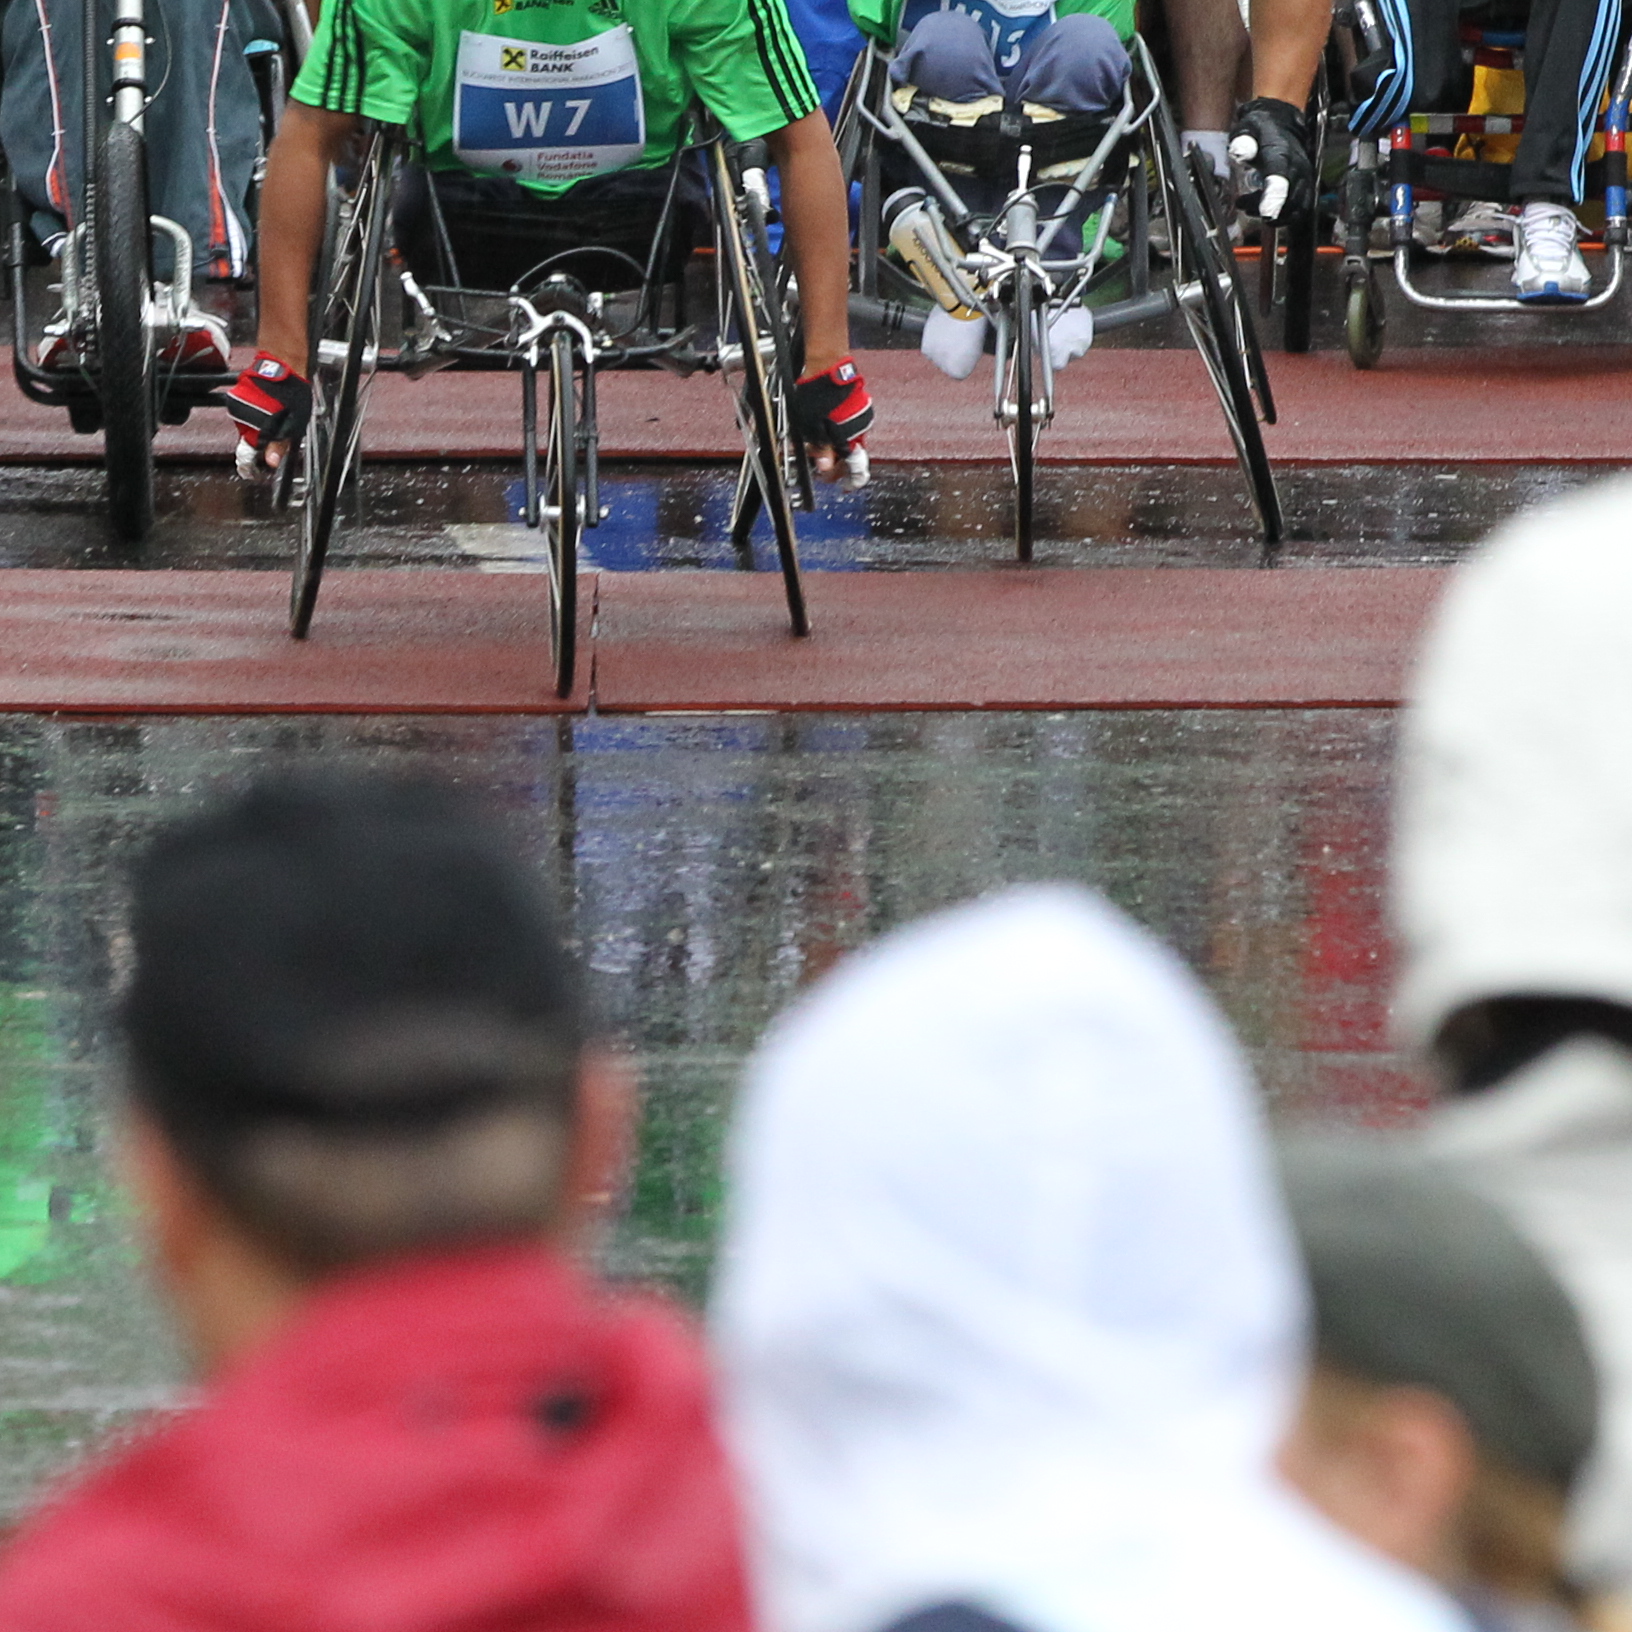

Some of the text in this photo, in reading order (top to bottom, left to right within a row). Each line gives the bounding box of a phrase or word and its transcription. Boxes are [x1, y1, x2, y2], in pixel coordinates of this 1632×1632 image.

[530, 46, 599, 60] Raiffeisen
[530, 63, 575, 73] BANK
[504, 99, 593, 139] W 7
